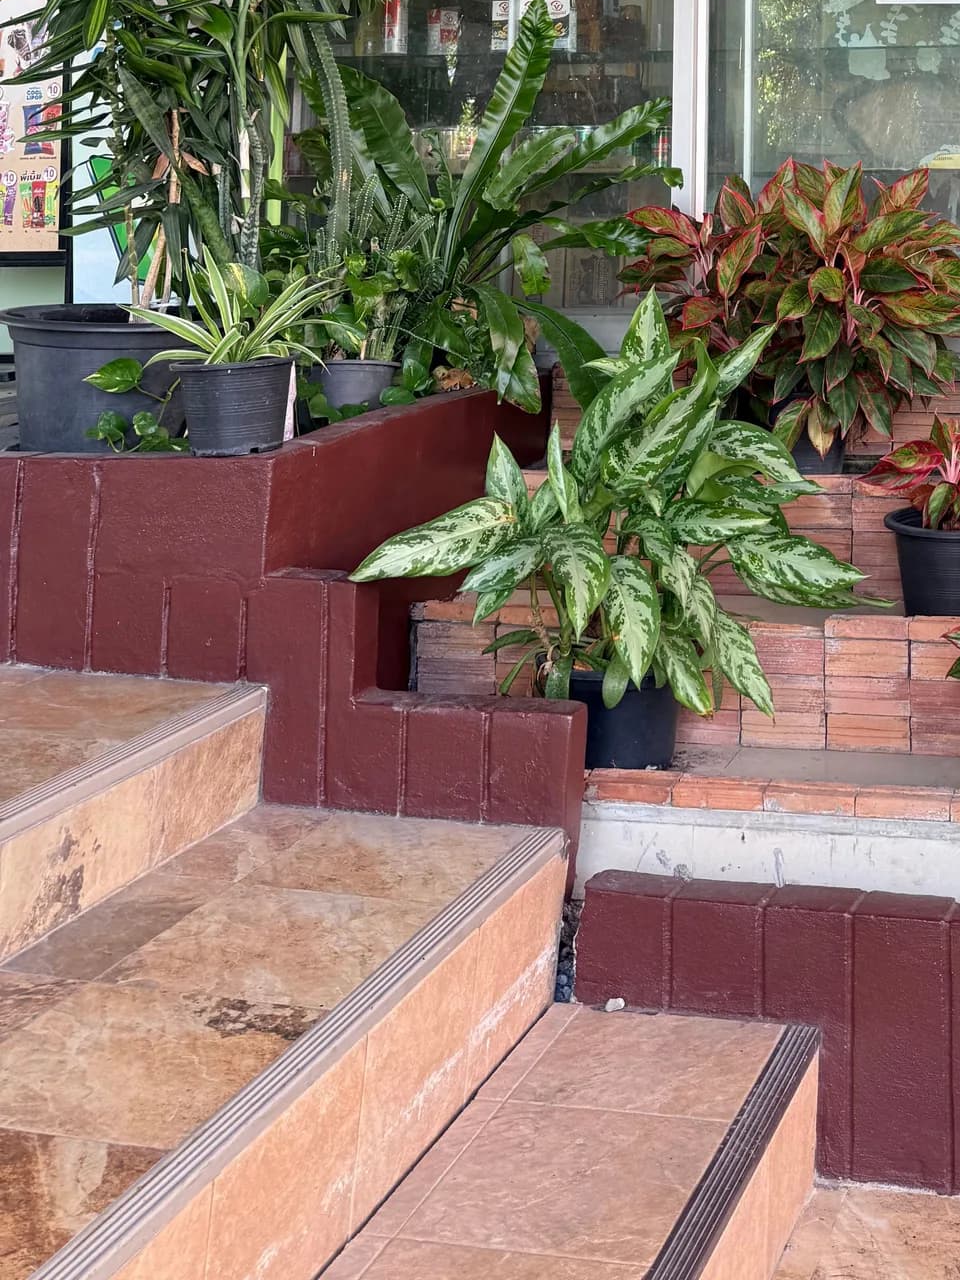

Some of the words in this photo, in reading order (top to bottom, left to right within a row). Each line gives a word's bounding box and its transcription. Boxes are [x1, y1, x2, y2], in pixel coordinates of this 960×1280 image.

[48, 85, 58, 94] 10
[4, 173, 15, 183] 10
[45, 168, 55, 178] 10
